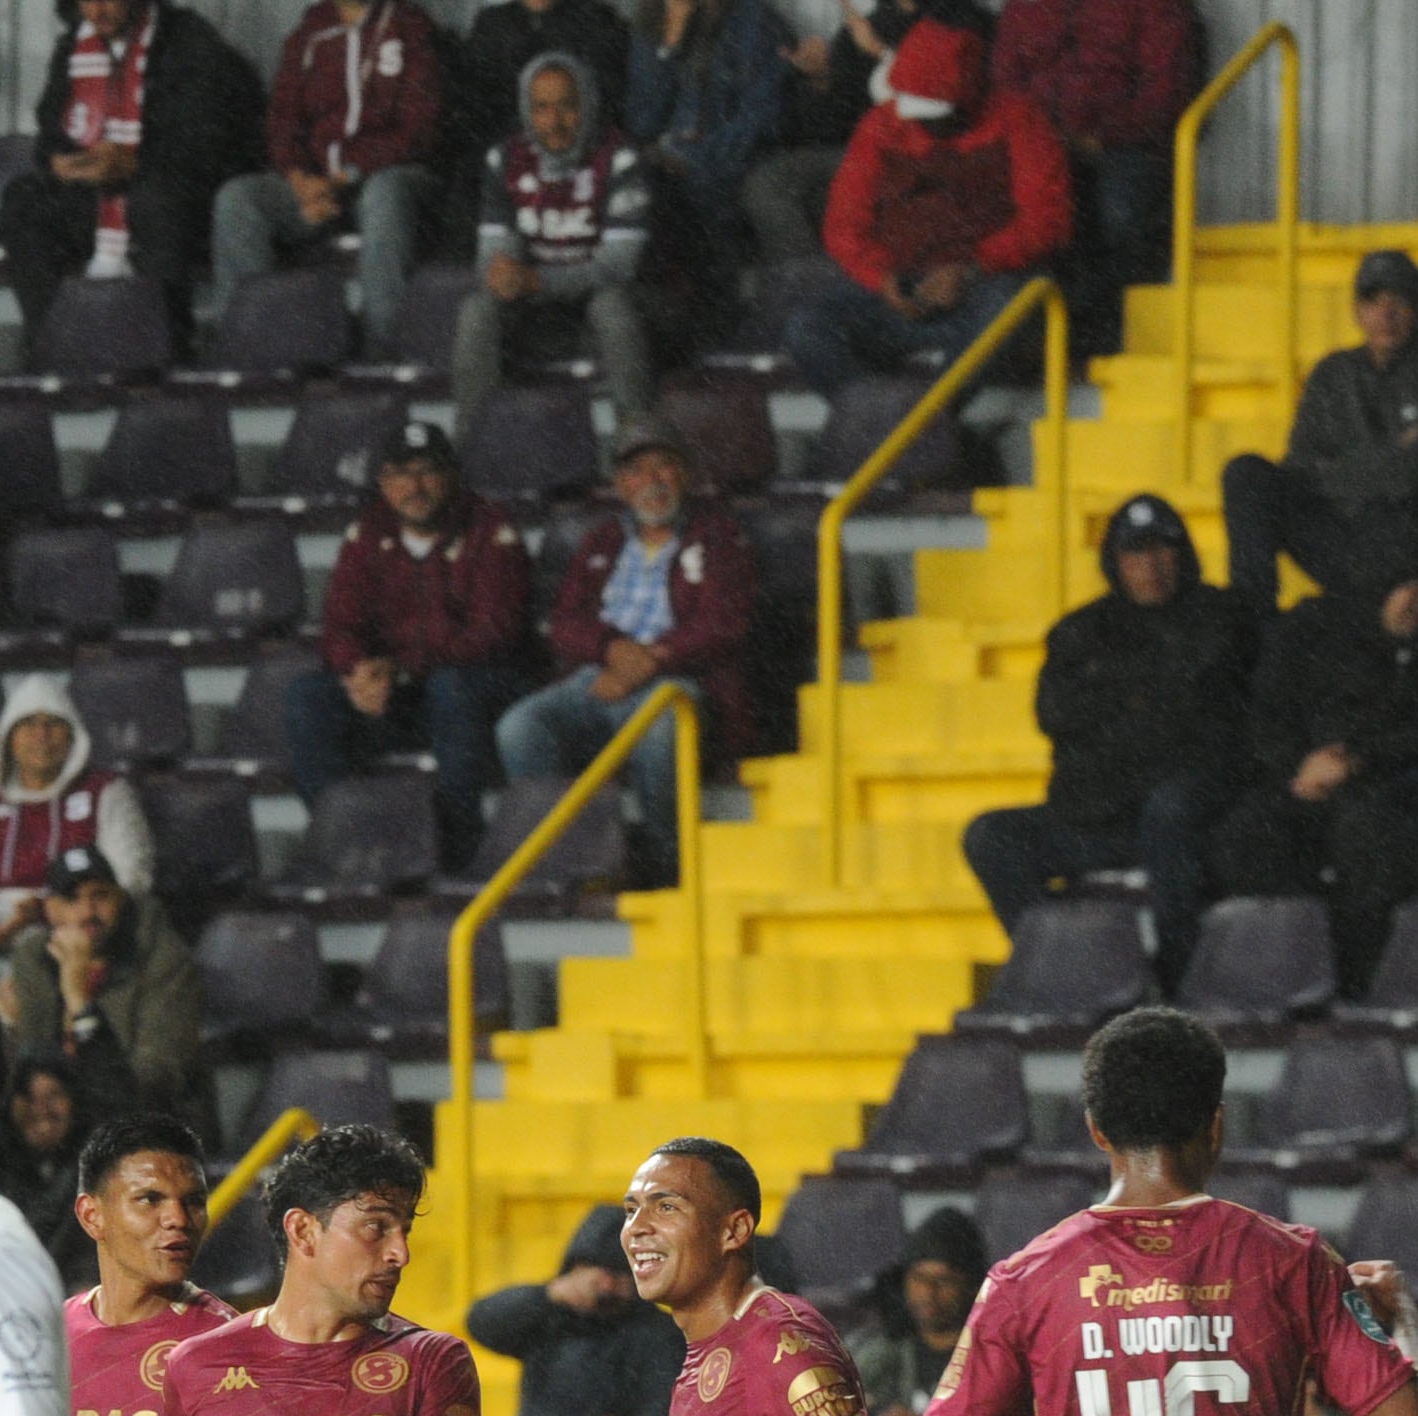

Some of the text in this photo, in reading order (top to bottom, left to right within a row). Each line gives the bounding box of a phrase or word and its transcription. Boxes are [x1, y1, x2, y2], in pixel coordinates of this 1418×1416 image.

[1107, 1277, 1233, 1311] medismart
[1082, 1315, 1234, 1360] D. WOODLY
